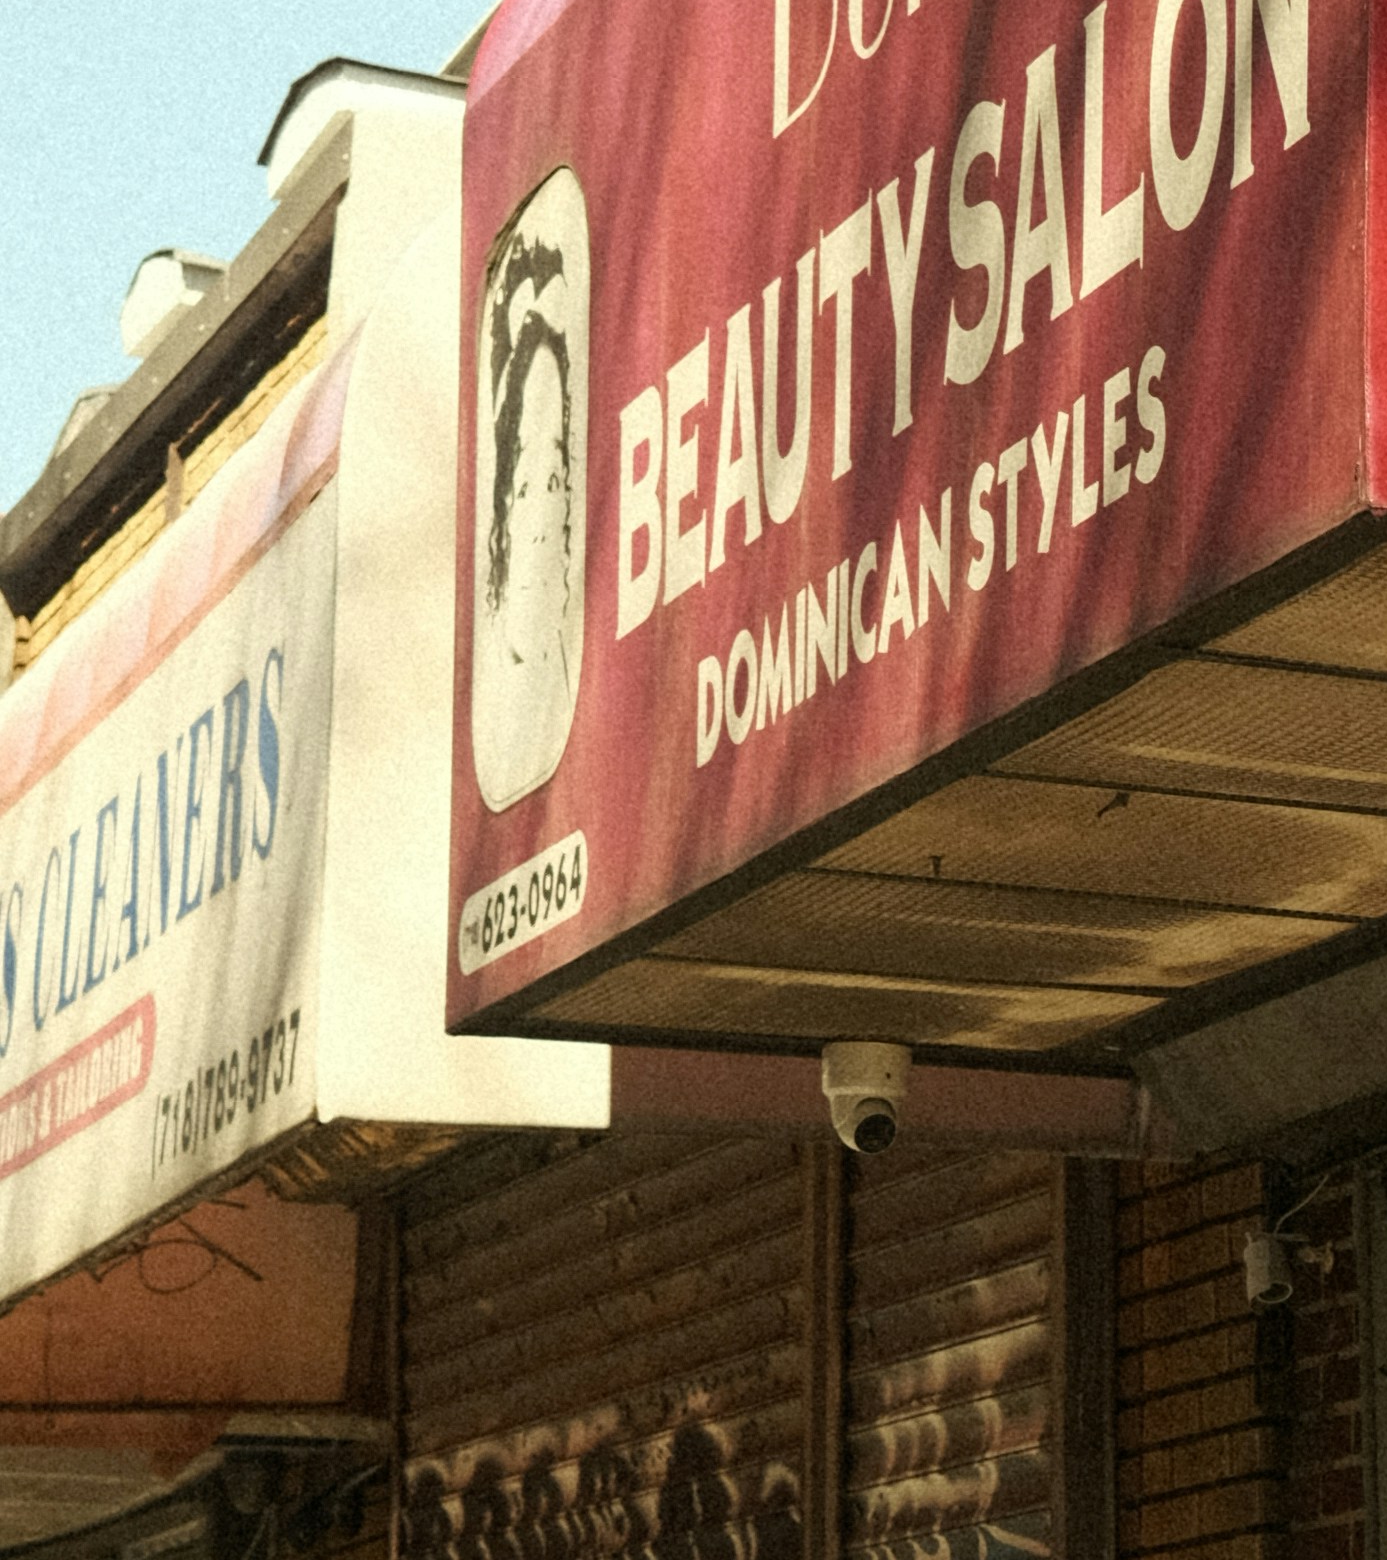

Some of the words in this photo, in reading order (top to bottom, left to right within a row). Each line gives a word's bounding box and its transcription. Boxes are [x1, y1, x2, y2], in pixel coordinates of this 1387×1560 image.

[614, 148, 936, 641] BEAUTY
[696, 485, 953, 767] DOMINICAN
[964, 346, 1166, 592] STYLES
[33, 642, 286, 1032] CLEANERS
[482, 844, 582, 954] 623-0964
[151, 1006, 301, 1180] (718)789-9737
